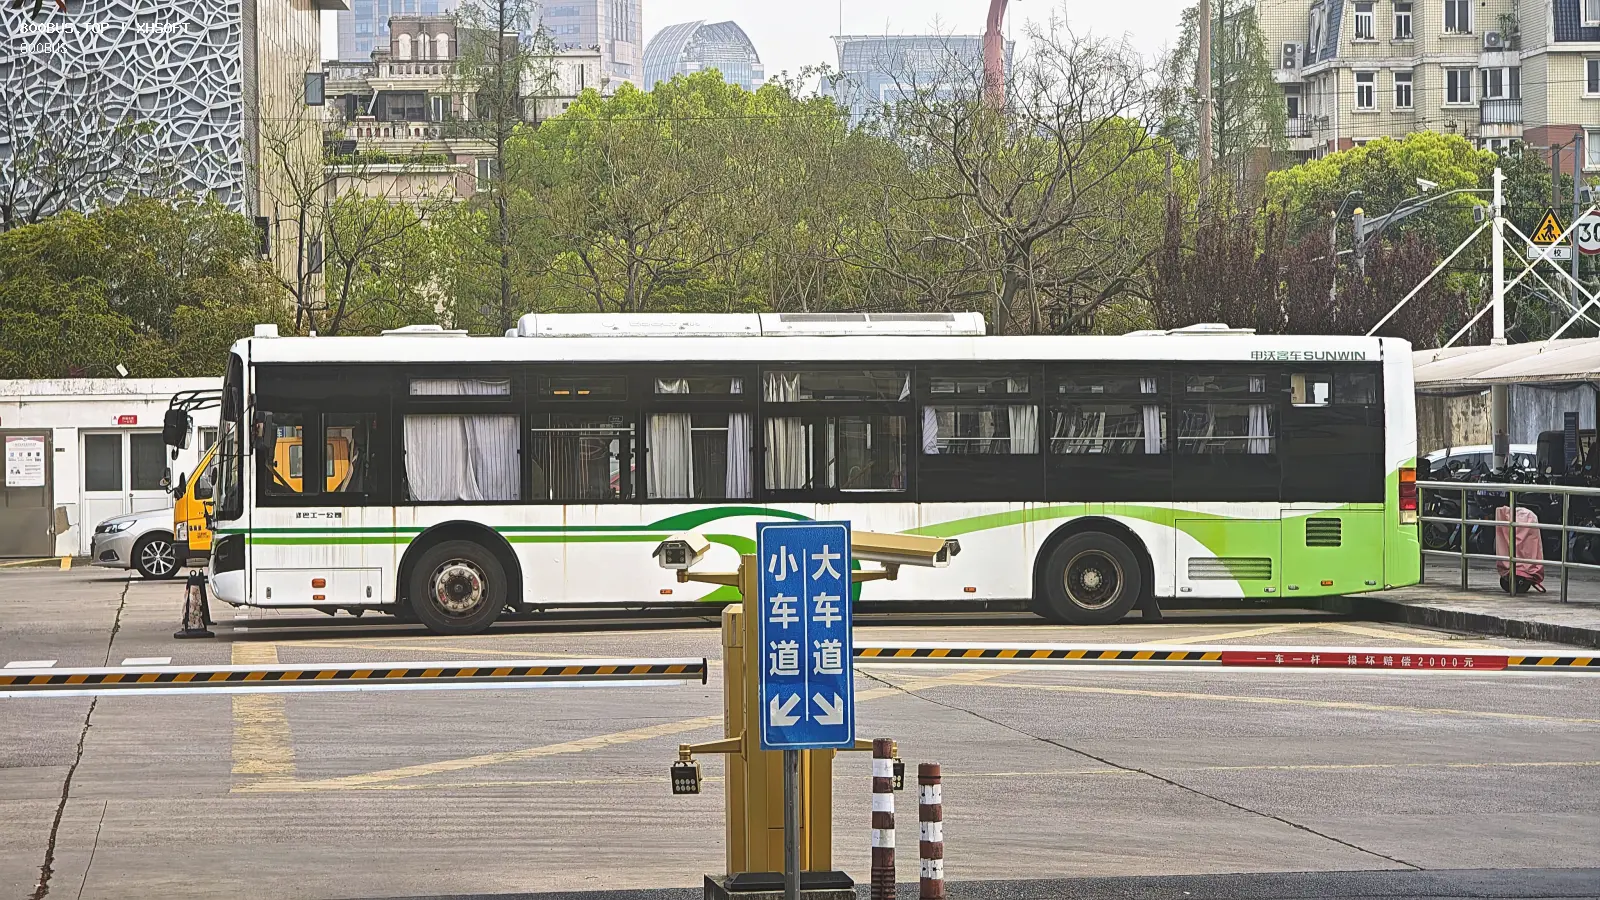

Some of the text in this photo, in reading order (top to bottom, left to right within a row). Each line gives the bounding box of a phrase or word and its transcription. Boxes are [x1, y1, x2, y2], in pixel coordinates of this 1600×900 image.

[1251, 350, 1366, 361] 申沃客车 SUNWIN
[768, 545, 800, 677] 小车道
[811, 545, 844, 676] 大车道
[1256, 653, 1474, 668] 一车一杆 损坏赔偿2000元
